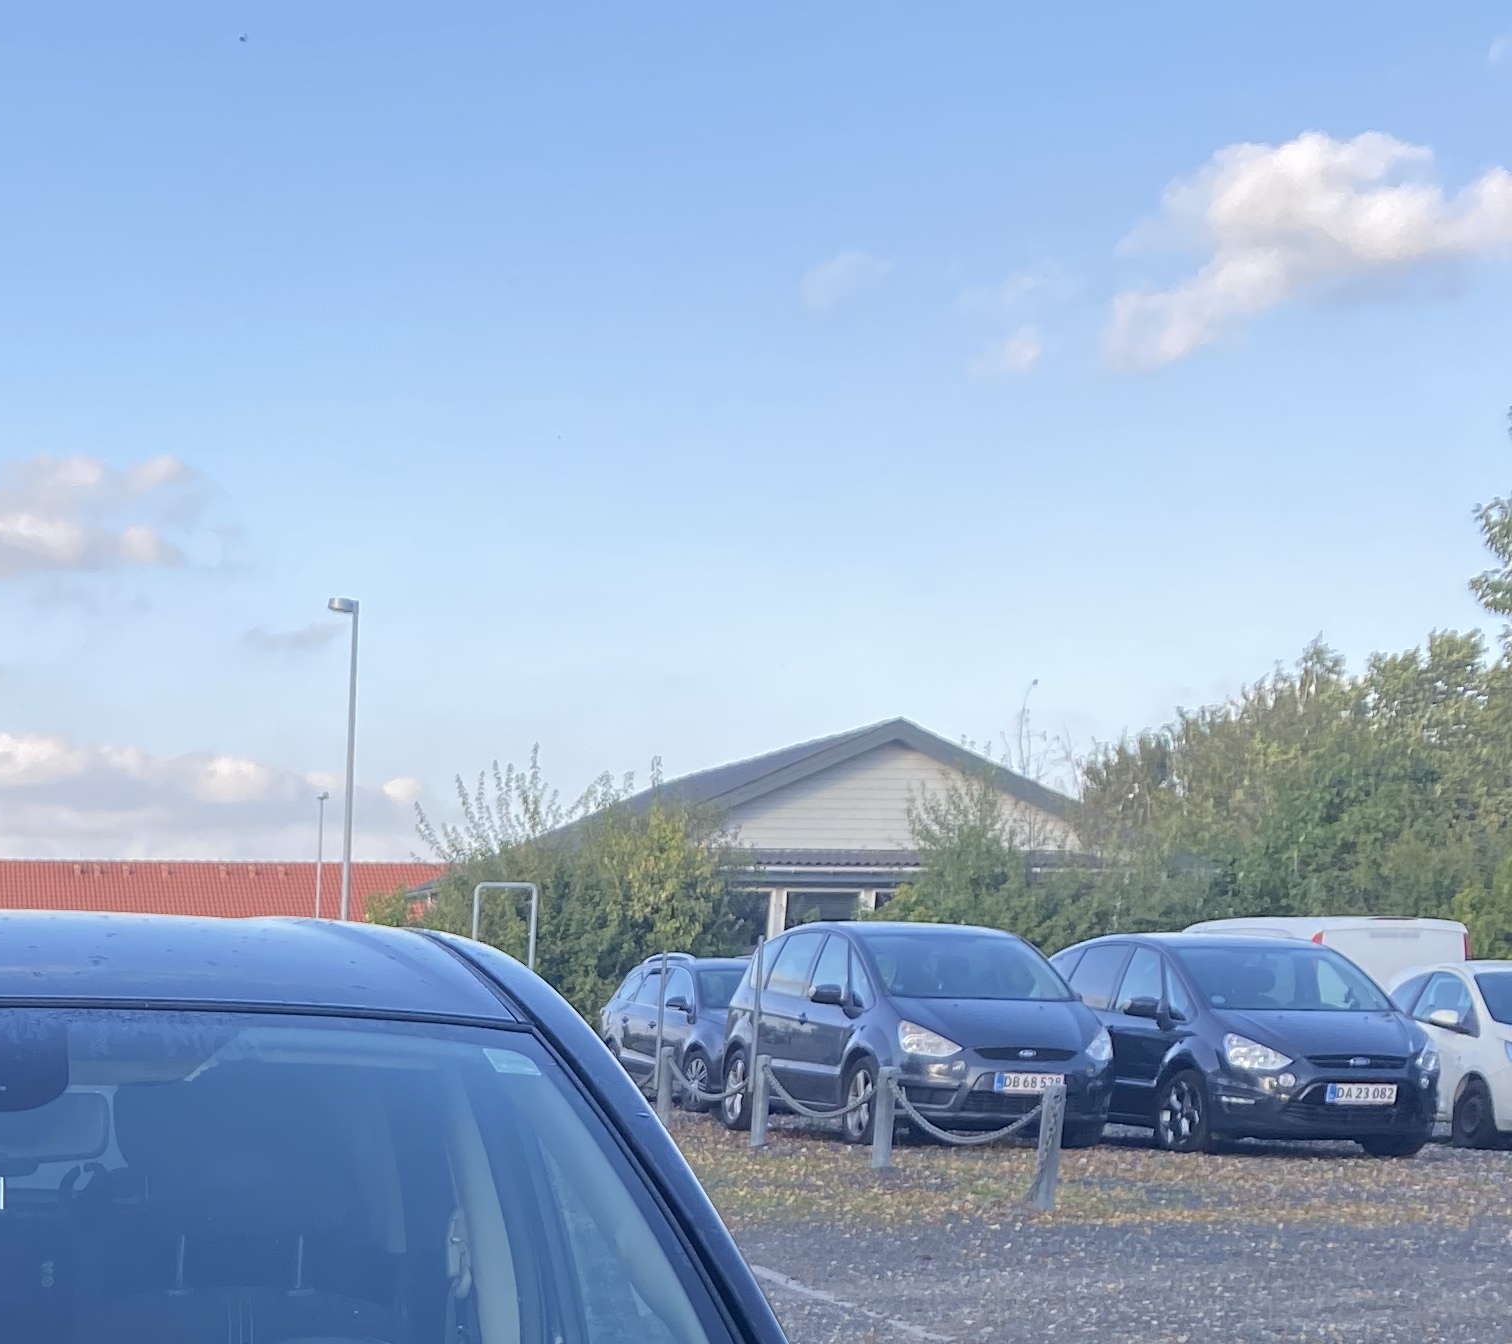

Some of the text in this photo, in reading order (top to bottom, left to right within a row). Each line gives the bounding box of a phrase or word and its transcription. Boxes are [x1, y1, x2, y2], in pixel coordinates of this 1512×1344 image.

[1004, 1075, 1020, 1088] DB
[1023, 1076, 1037, 1089] 68
[1336, 1087, 1394, 1099] DA 23 082
